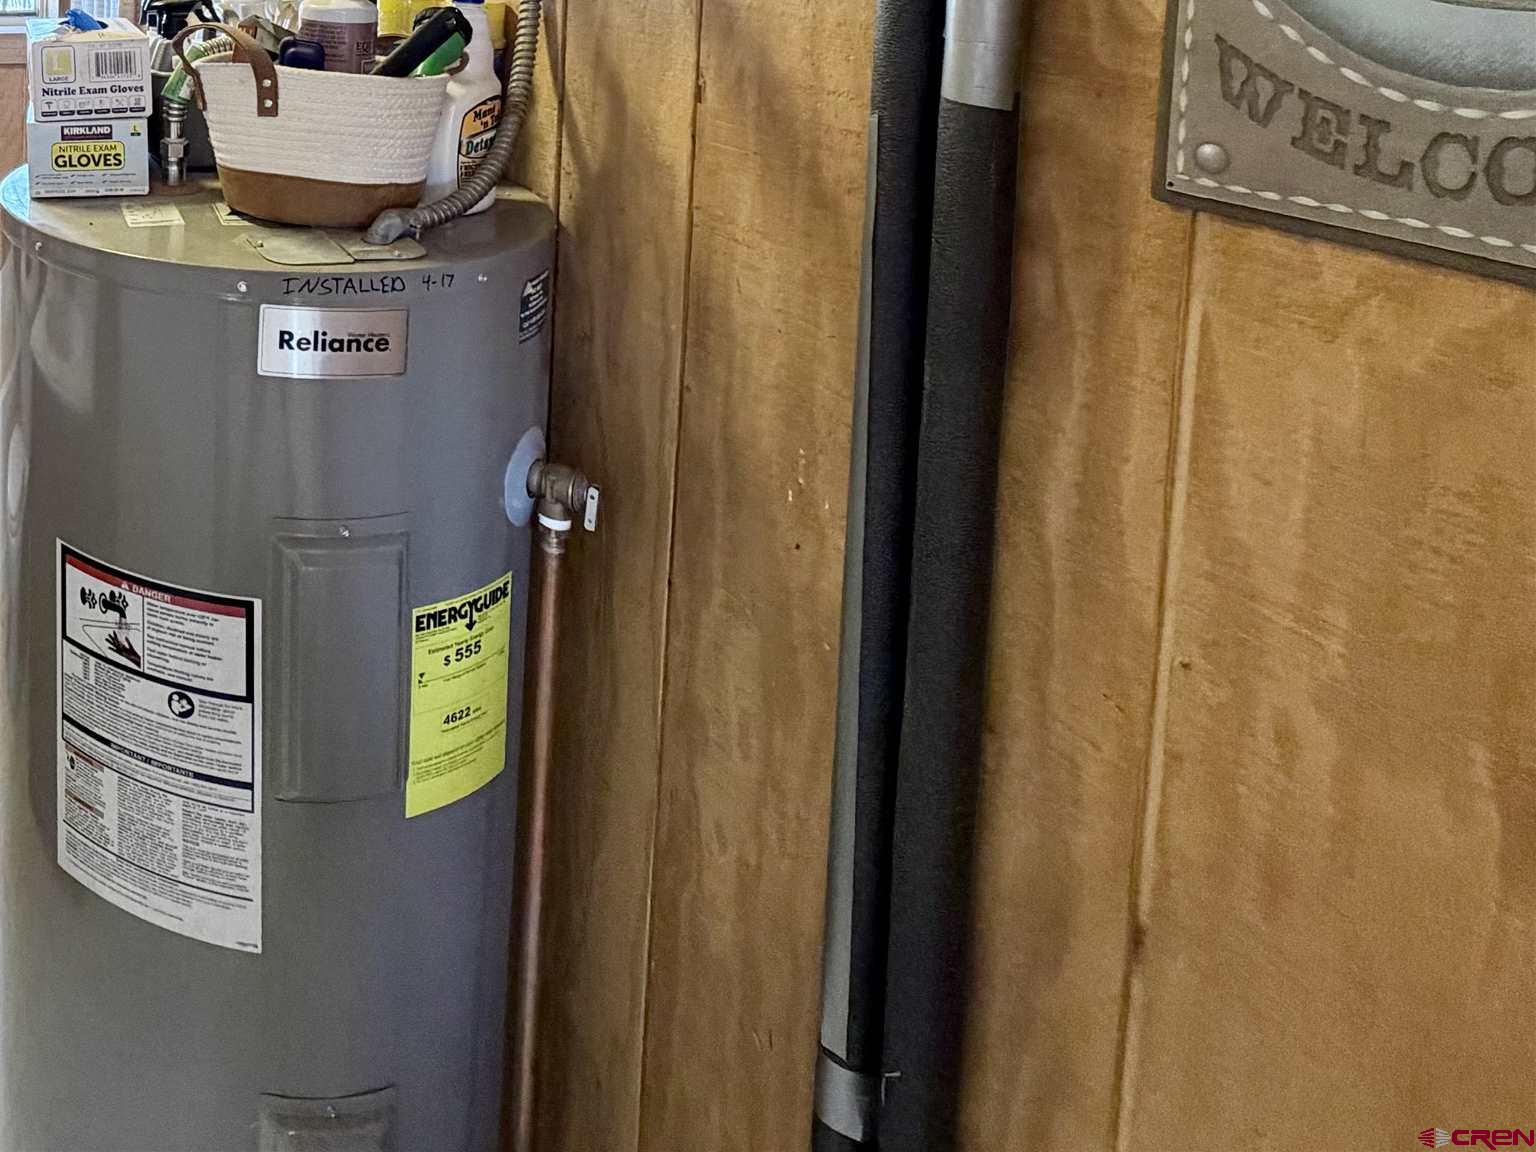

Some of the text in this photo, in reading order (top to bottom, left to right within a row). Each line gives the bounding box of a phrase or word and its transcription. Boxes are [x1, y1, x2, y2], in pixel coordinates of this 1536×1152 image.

[41, 84, 145, 97] Nitrile Exam Gloves
[63, 126, 111, 136] KIRKLAND
[58, 144, 118, 153] NITRILE EXAM
[54, 153, 123, 168] GLOVES
[282, 273, 455, 296] INSTALLED 4-17
[278, 330, 391, 353] Reliance
[132, 584, 173, 603] DANGER
[455, 639, 482, 663] 555
[443, 706, 472, 725] 4622
